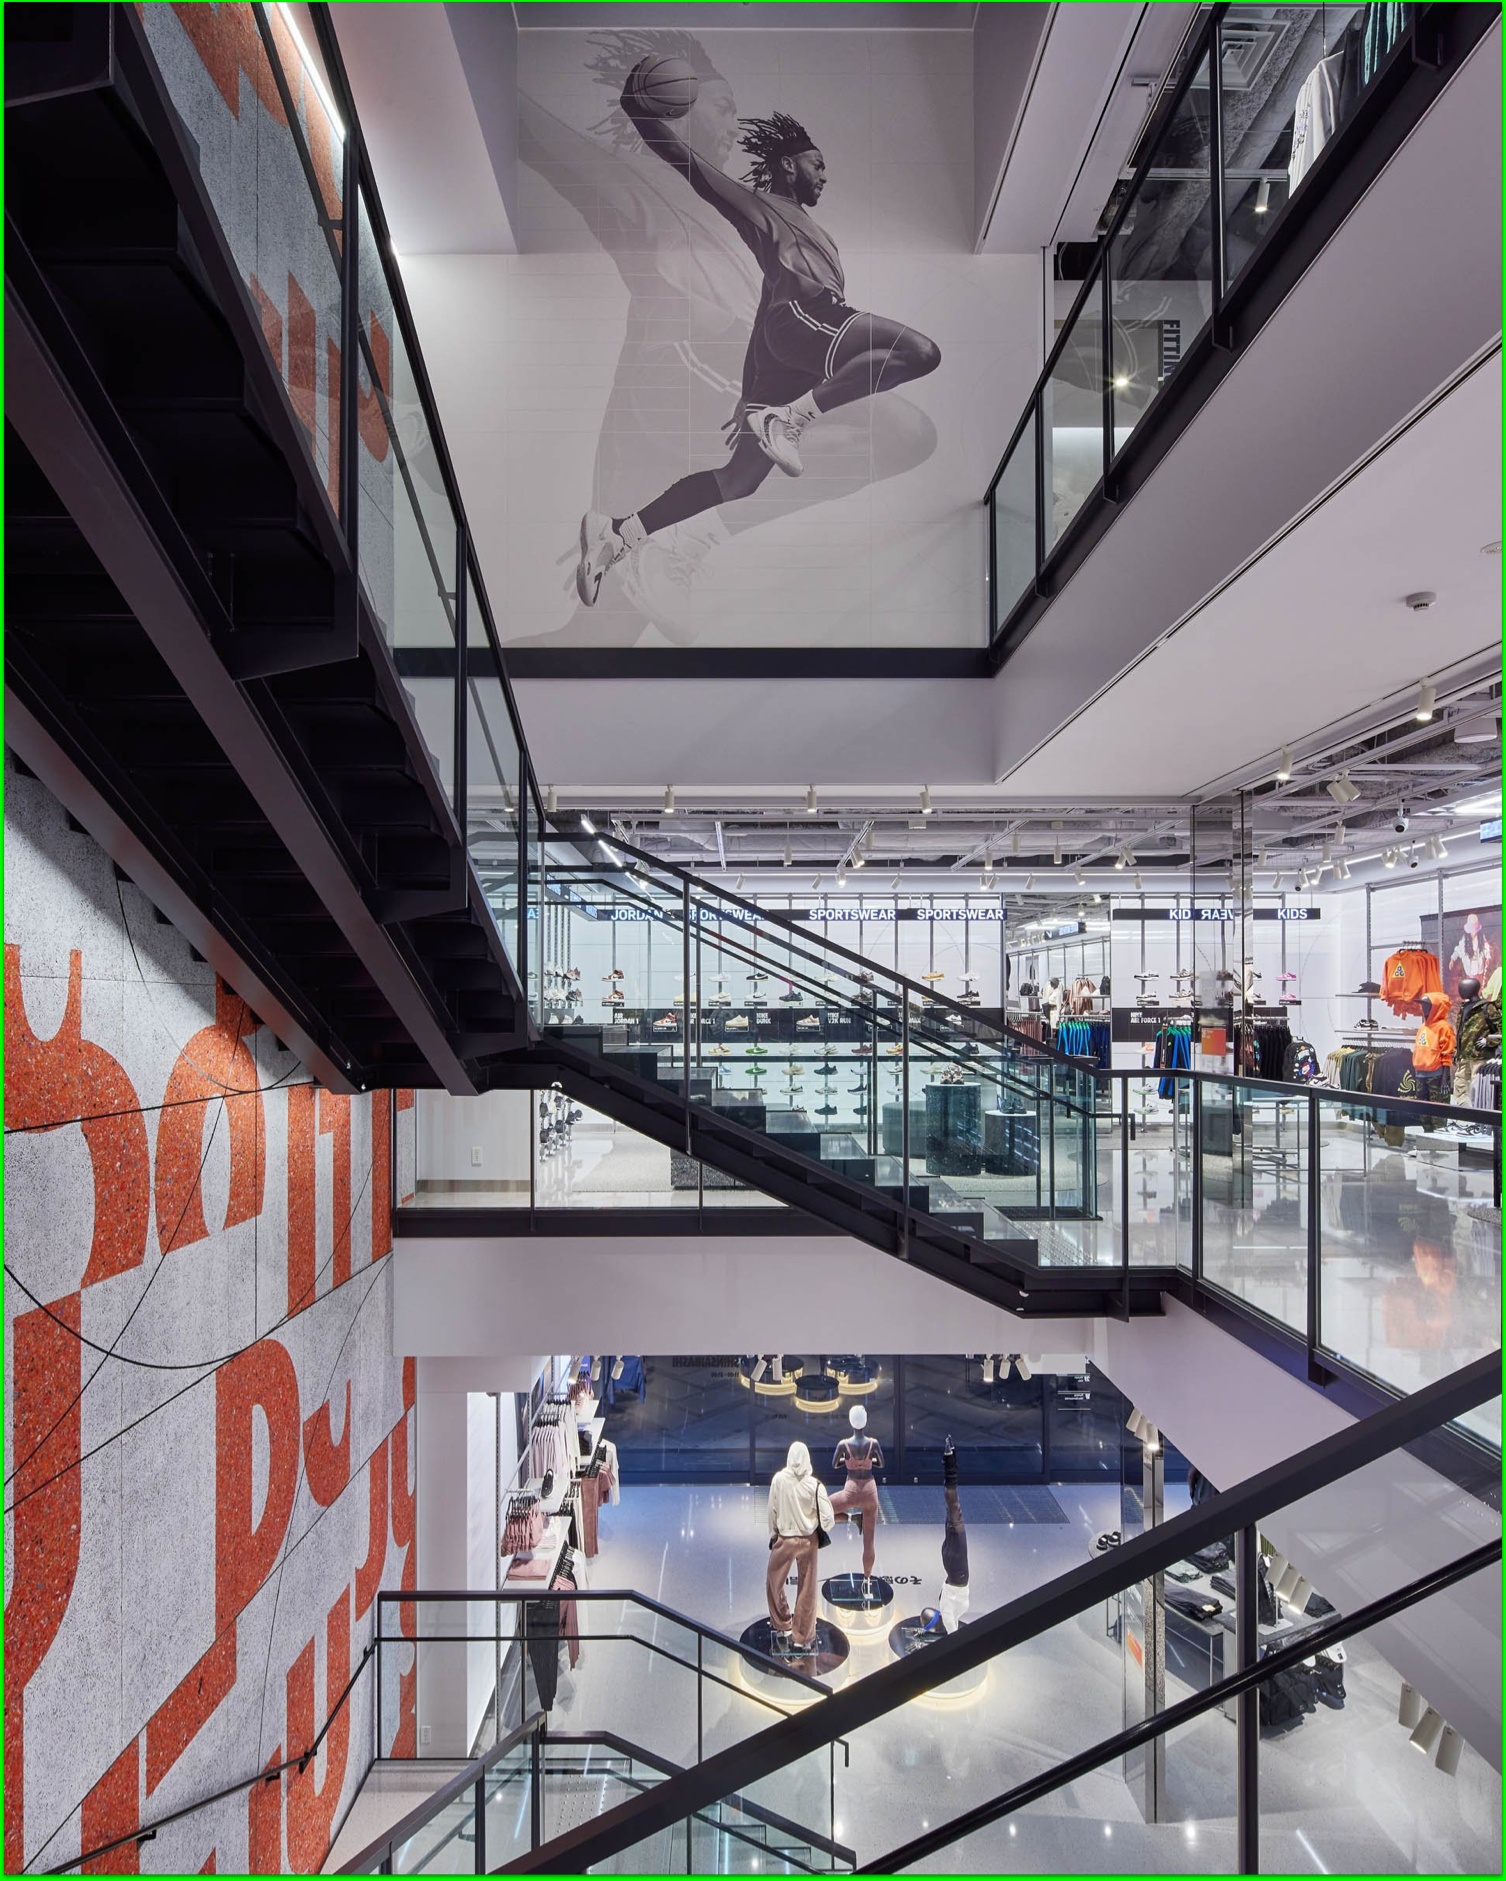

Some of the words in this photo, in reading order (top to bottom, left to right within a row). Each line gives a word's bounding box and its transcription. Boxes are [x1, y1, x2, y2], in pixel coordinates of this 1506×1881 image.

[808, 909, 896, 920] SPORTSWEAR
[917, 909, 1004, 920] SPORTSWEAR
[1277, 908, 1308, 920] KIDS
